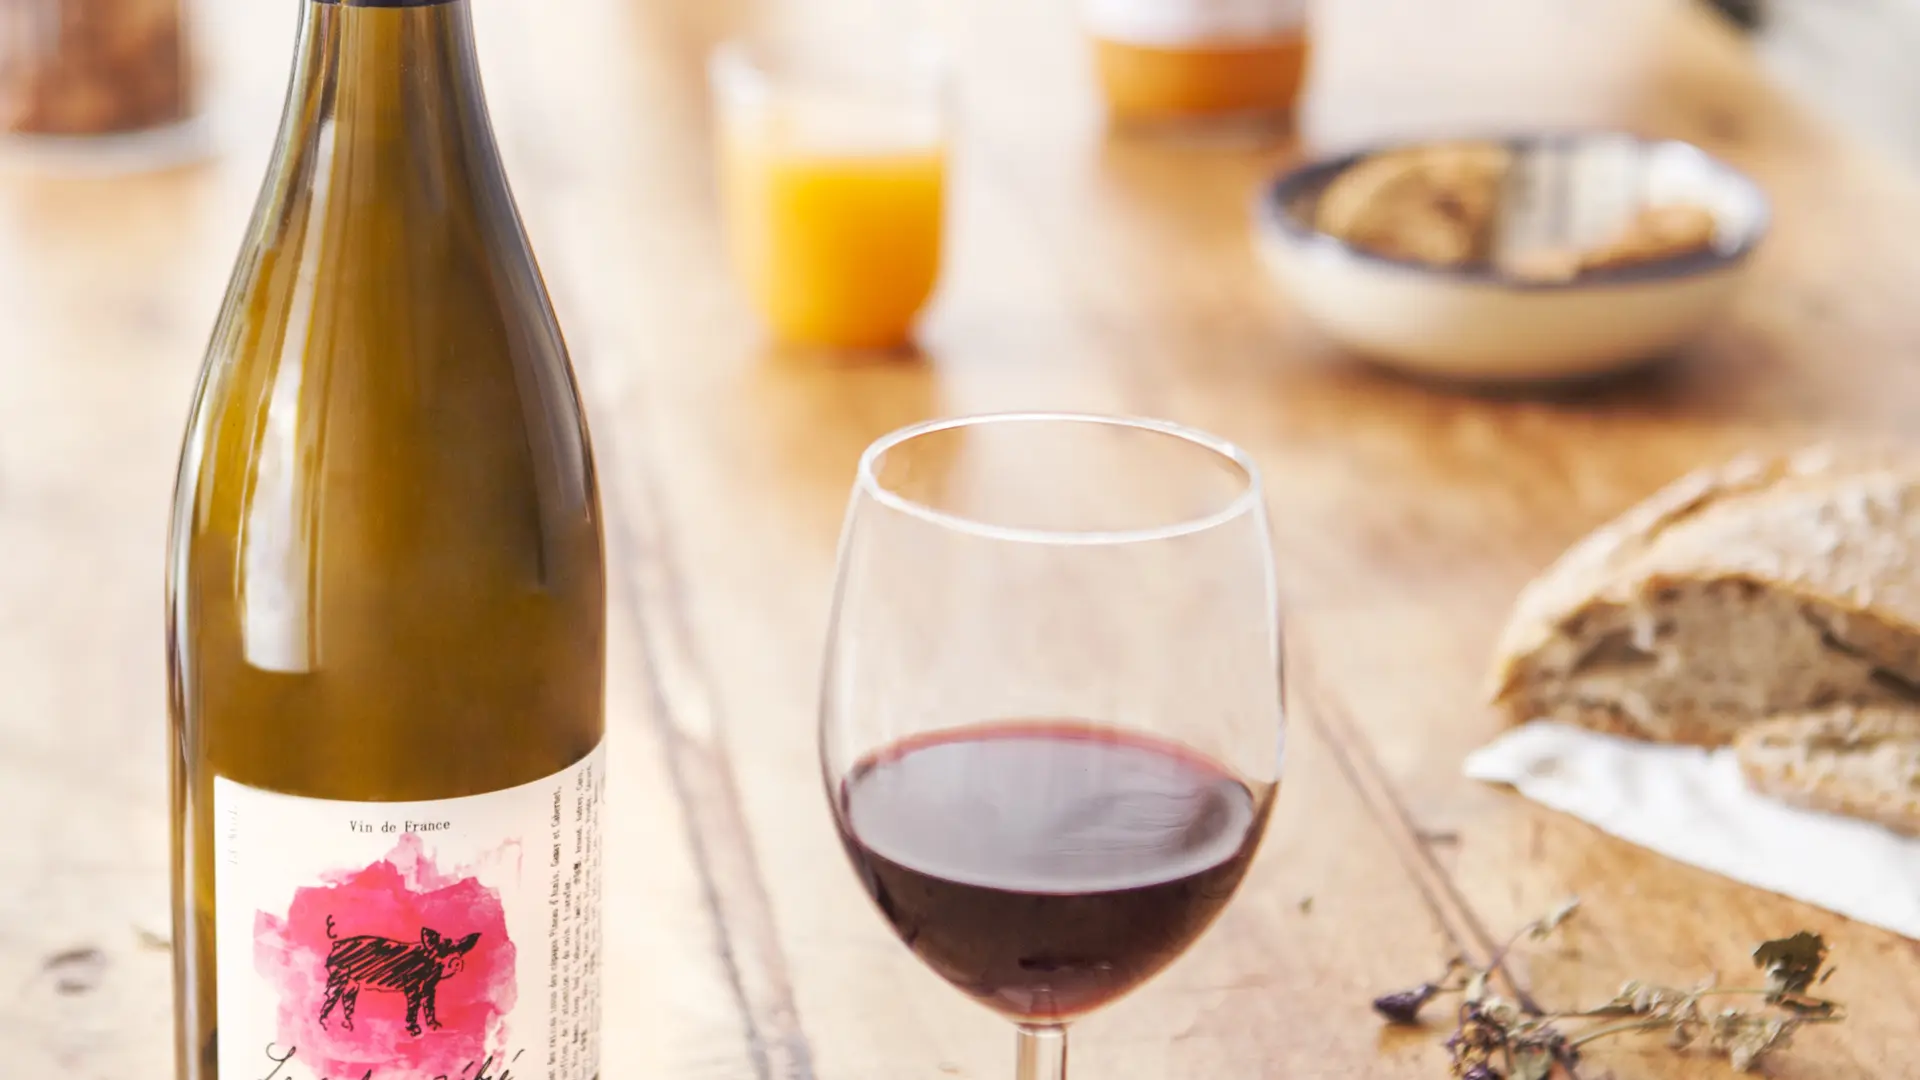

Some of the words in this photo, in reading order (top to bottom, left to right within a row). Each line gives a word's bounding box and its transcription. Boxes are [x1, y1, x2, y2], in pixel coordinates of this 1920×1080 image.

[550, 786, 562, 828] Cabernet,
[349, 820, 373, 833] Vin
[381, 821, 397, 833] de
[404, 820, 451, 833] France
[552, 830, 560, 840] et
[550, 843, 562, 868] Gamay
